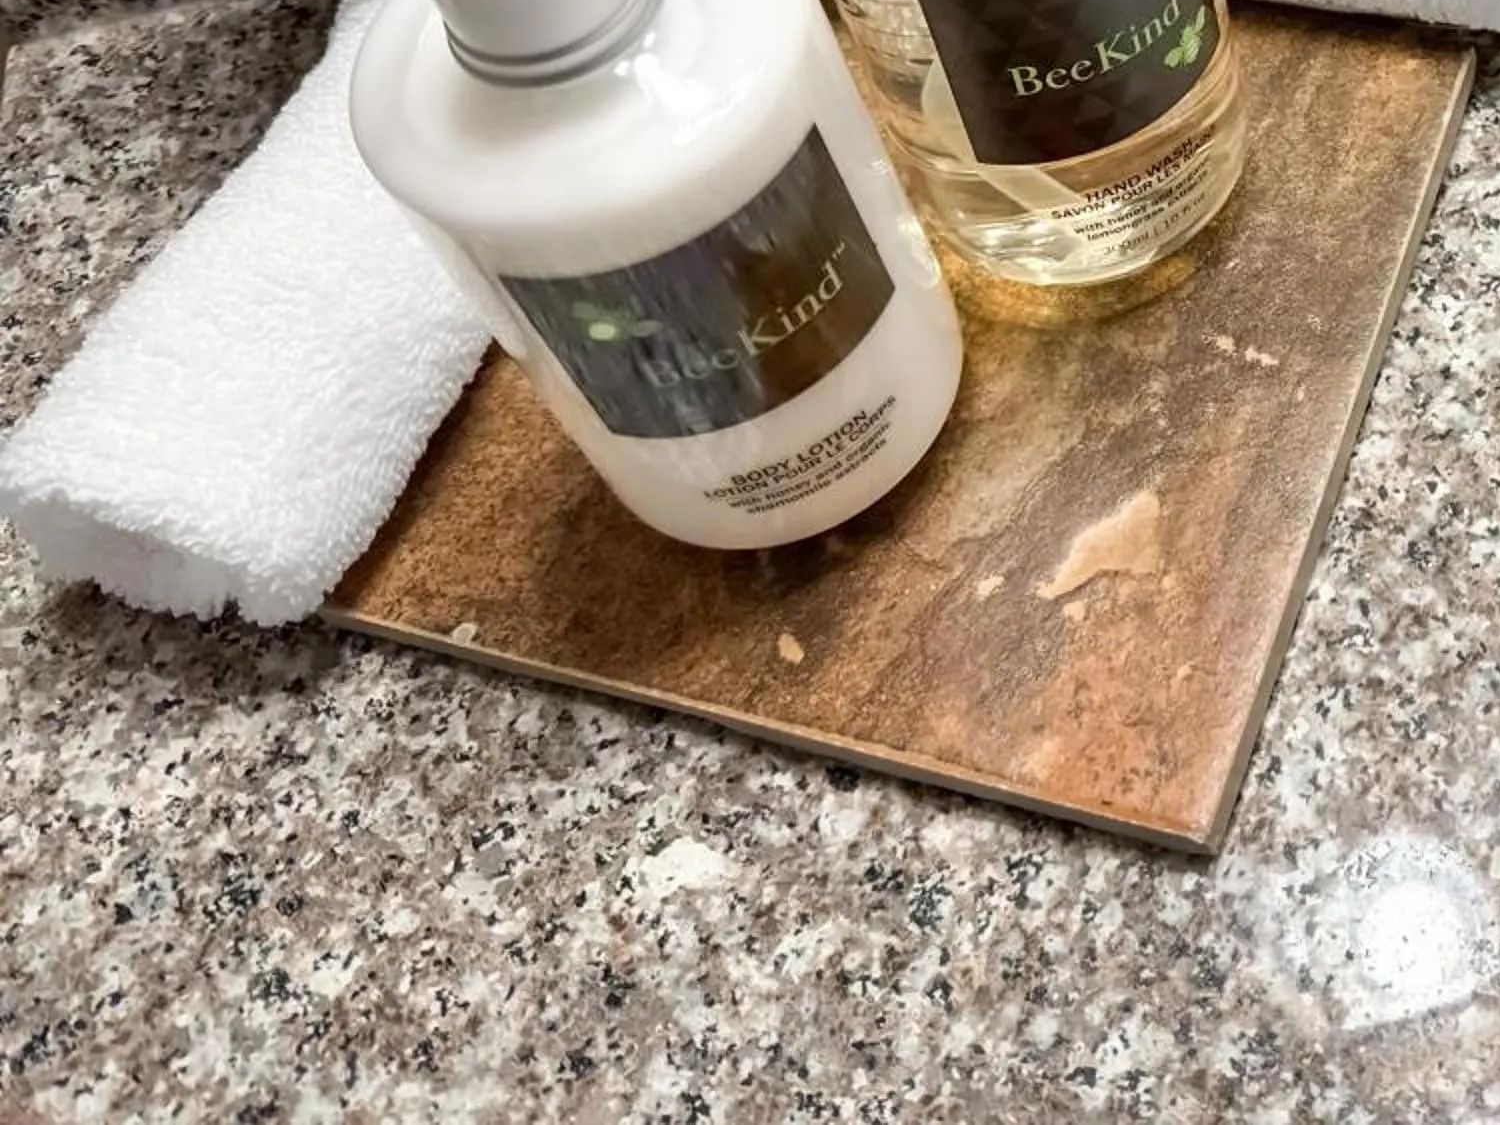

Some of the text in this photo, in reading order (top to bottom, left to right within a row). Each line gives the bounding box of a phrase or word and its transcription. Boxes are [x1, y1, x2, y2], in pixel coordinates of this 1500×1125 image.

[1051, 201, 1106, 220] SAVON
[1111, 180, 1154, 205] POUR
[1156, 163, 1181, 184] LES
[1085, 138, 1194, 203] HAND WASH
[1073, 221, 1105, 235] with
[1107, 205, 1148, 226] honey
[1151, 187, 1174, 207] and
[1087, 206, 1165, 242] lemongrass
[703, 394, 896, 500] LOTION POUR LE CORPS
[731, 410, 868, 486] BODY LOTION
[728, 496, 762, 509] with
[765, 479, 811, 502] honey
[815, 460, 843, 480] and
